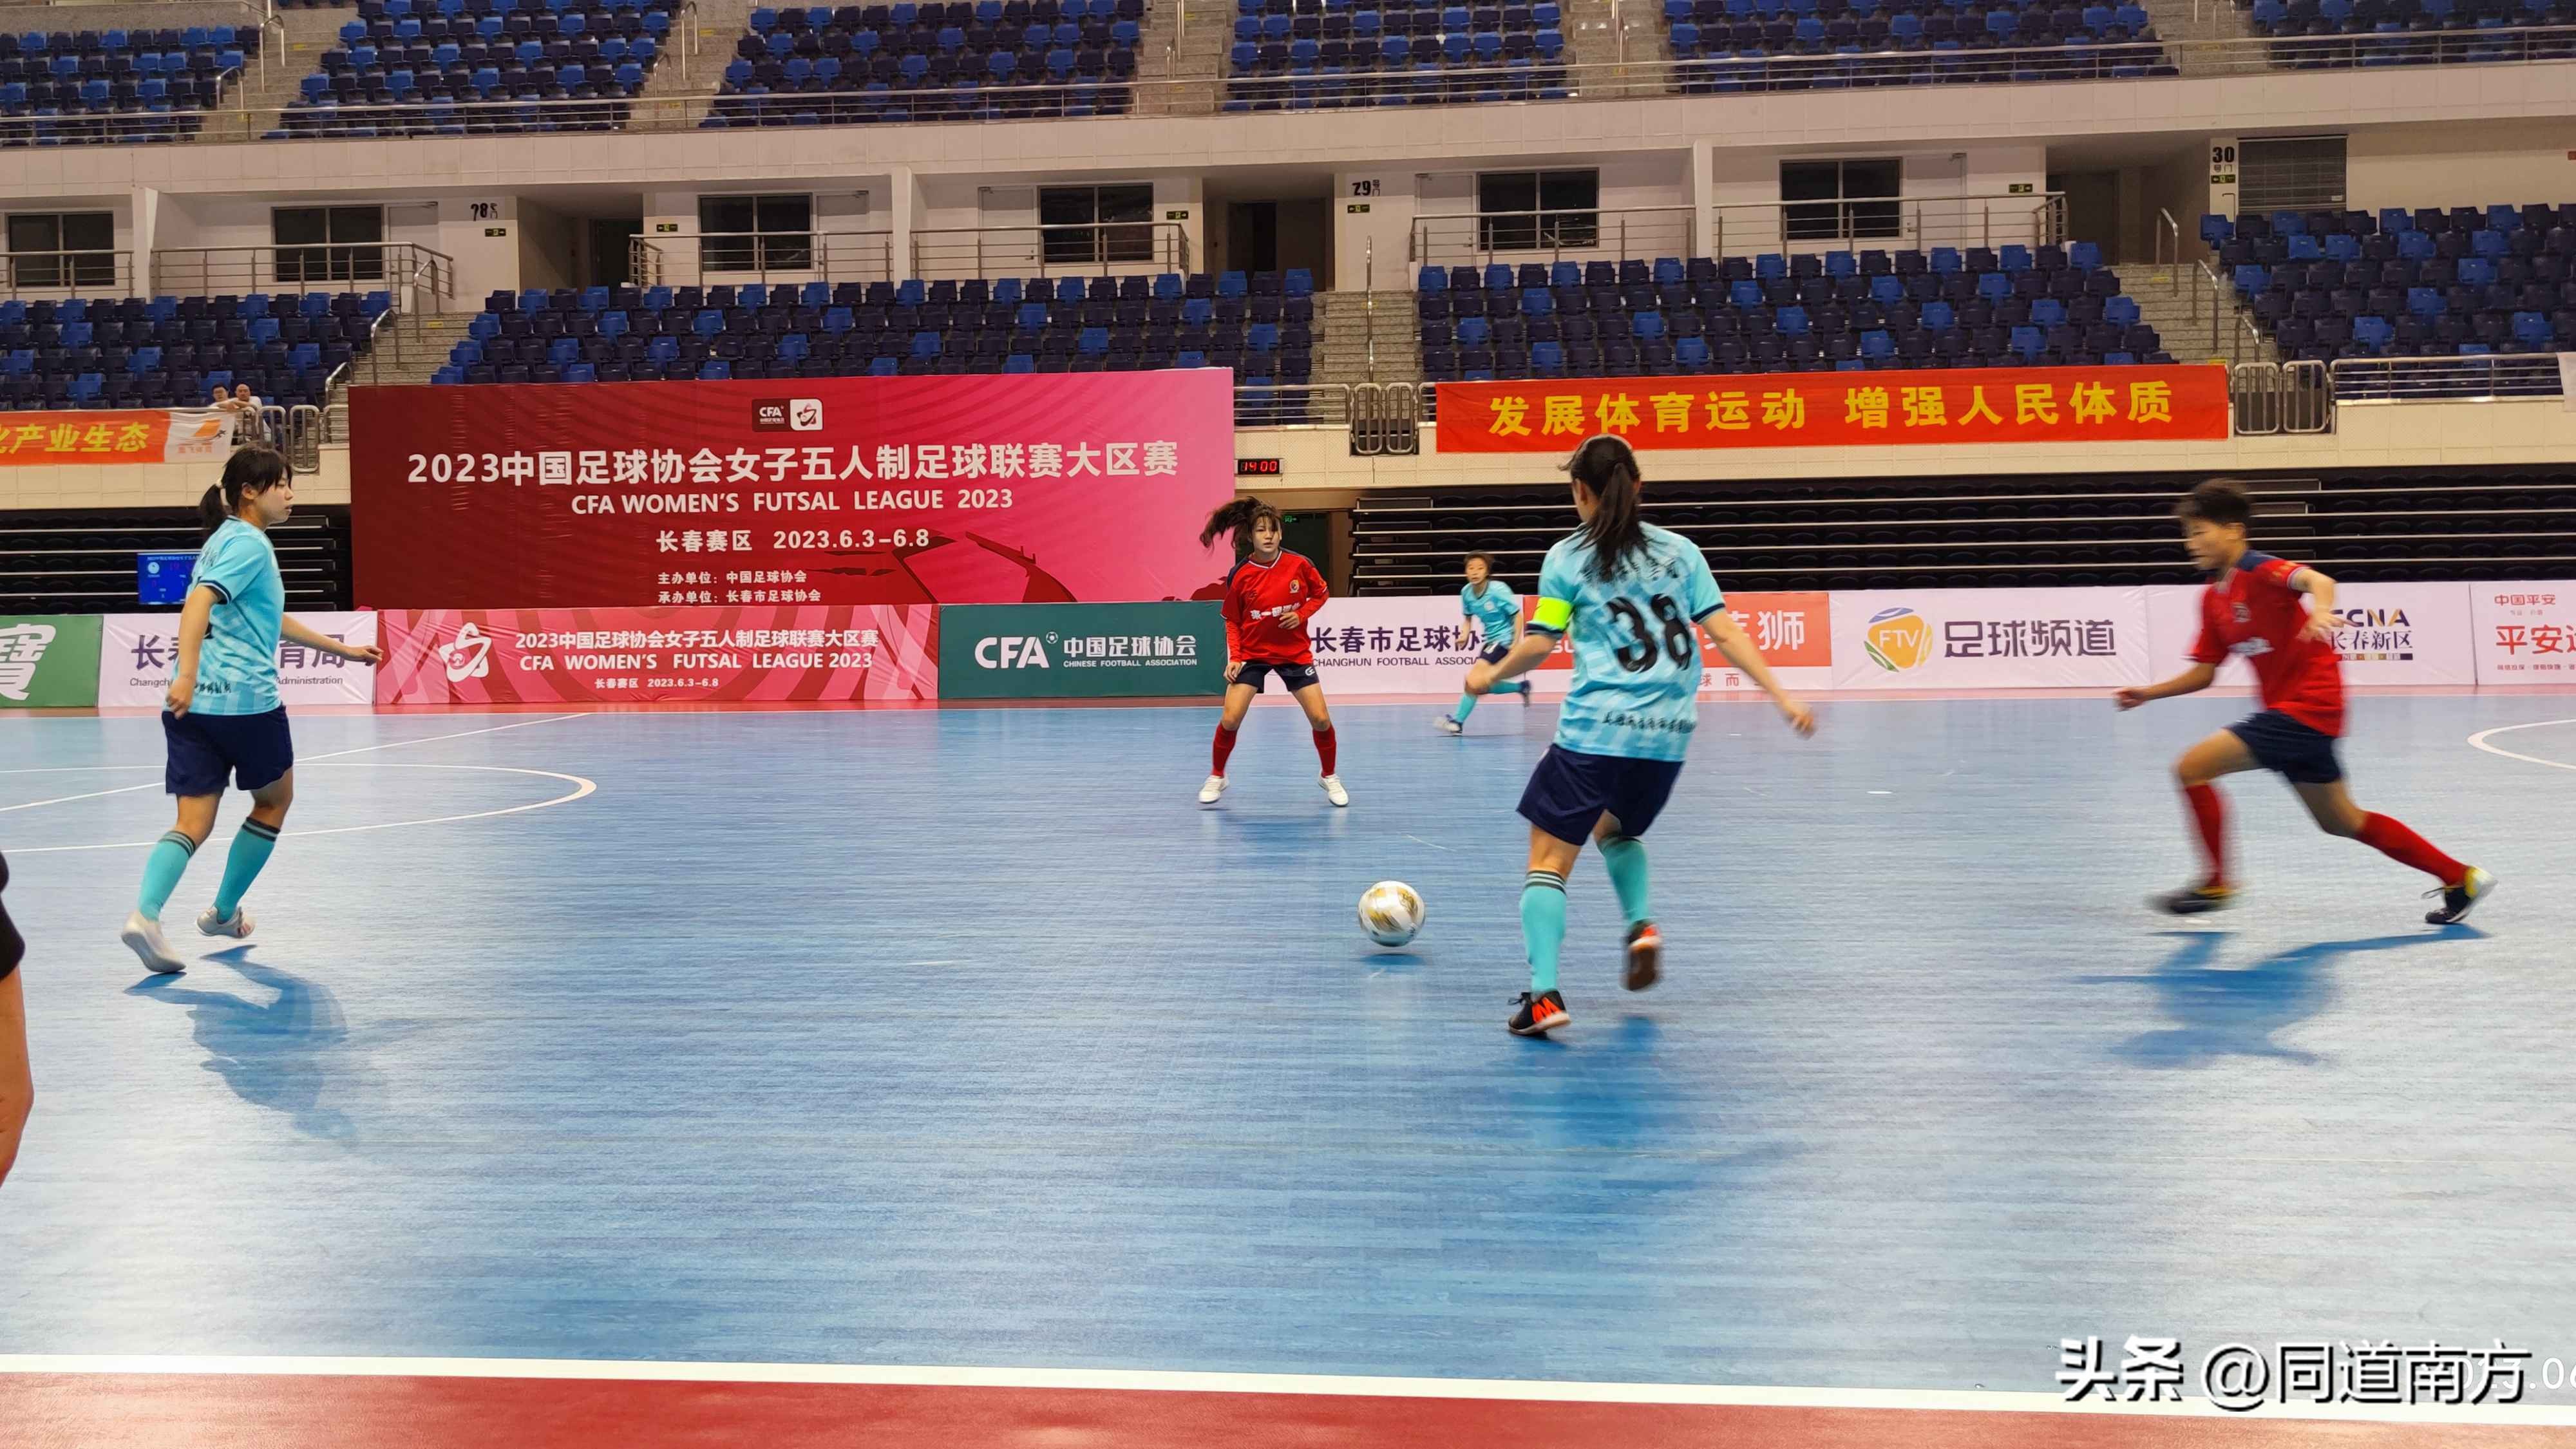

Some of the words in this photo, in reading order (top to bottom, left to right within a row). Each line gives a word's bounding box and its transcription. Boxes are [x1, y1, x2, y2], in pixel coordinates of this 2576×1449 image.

[2212, 146, 2235, 163] 30
[759, 406, 782, 417] CFA
[1488, 388, 1805, 437] 发展体育运动
[1844, 381, 2172, 428] 增强人民体质
[408, 440, 1179, 486] 2023中国足球协会女子五人制足球联赛大区赛
[571, 495, 615, 515] CFA
[621, 493, 739, 514] WOMEN'S
[753, 491, 840, 511] FUTSAL
[854, 489, 943, 510] LEAGUE
[958, 488, 1013, 509] 2023
[656, 529, 753, 553] 长春赛区
[2494, 594, 2556, 606] 中国平安
[2330, 609, 2410, 627] CNA
[515, 629, 879, 650] 2023中国足球协会女子五人制足球联赛大区赛
[1311, 625, 1487, 653] 长春市足球协
[1605, 593, 1693, 674] 38
[1879, 629, 1919, 649] FTV
[1944, 620, 2117, 658] 足球频道
[974, 636, 1050, 669] CFA
[1063, 634, 1197, 659] 中国足球协会
[520, 654, 554, 671] CFA
[564, 653, 657, 670] WOMEN'S
[673, 652, 743, 669] FUTSAL
[752, 652, 824, 668] LEAGUE
[828, 652, 873, 668] 2023
[1145, 658, 1198, 667] ASSOCIATION
[1377, 657, 1430, 666] FOOTBALL
[594, 677, 639, 689] 长春赛区
